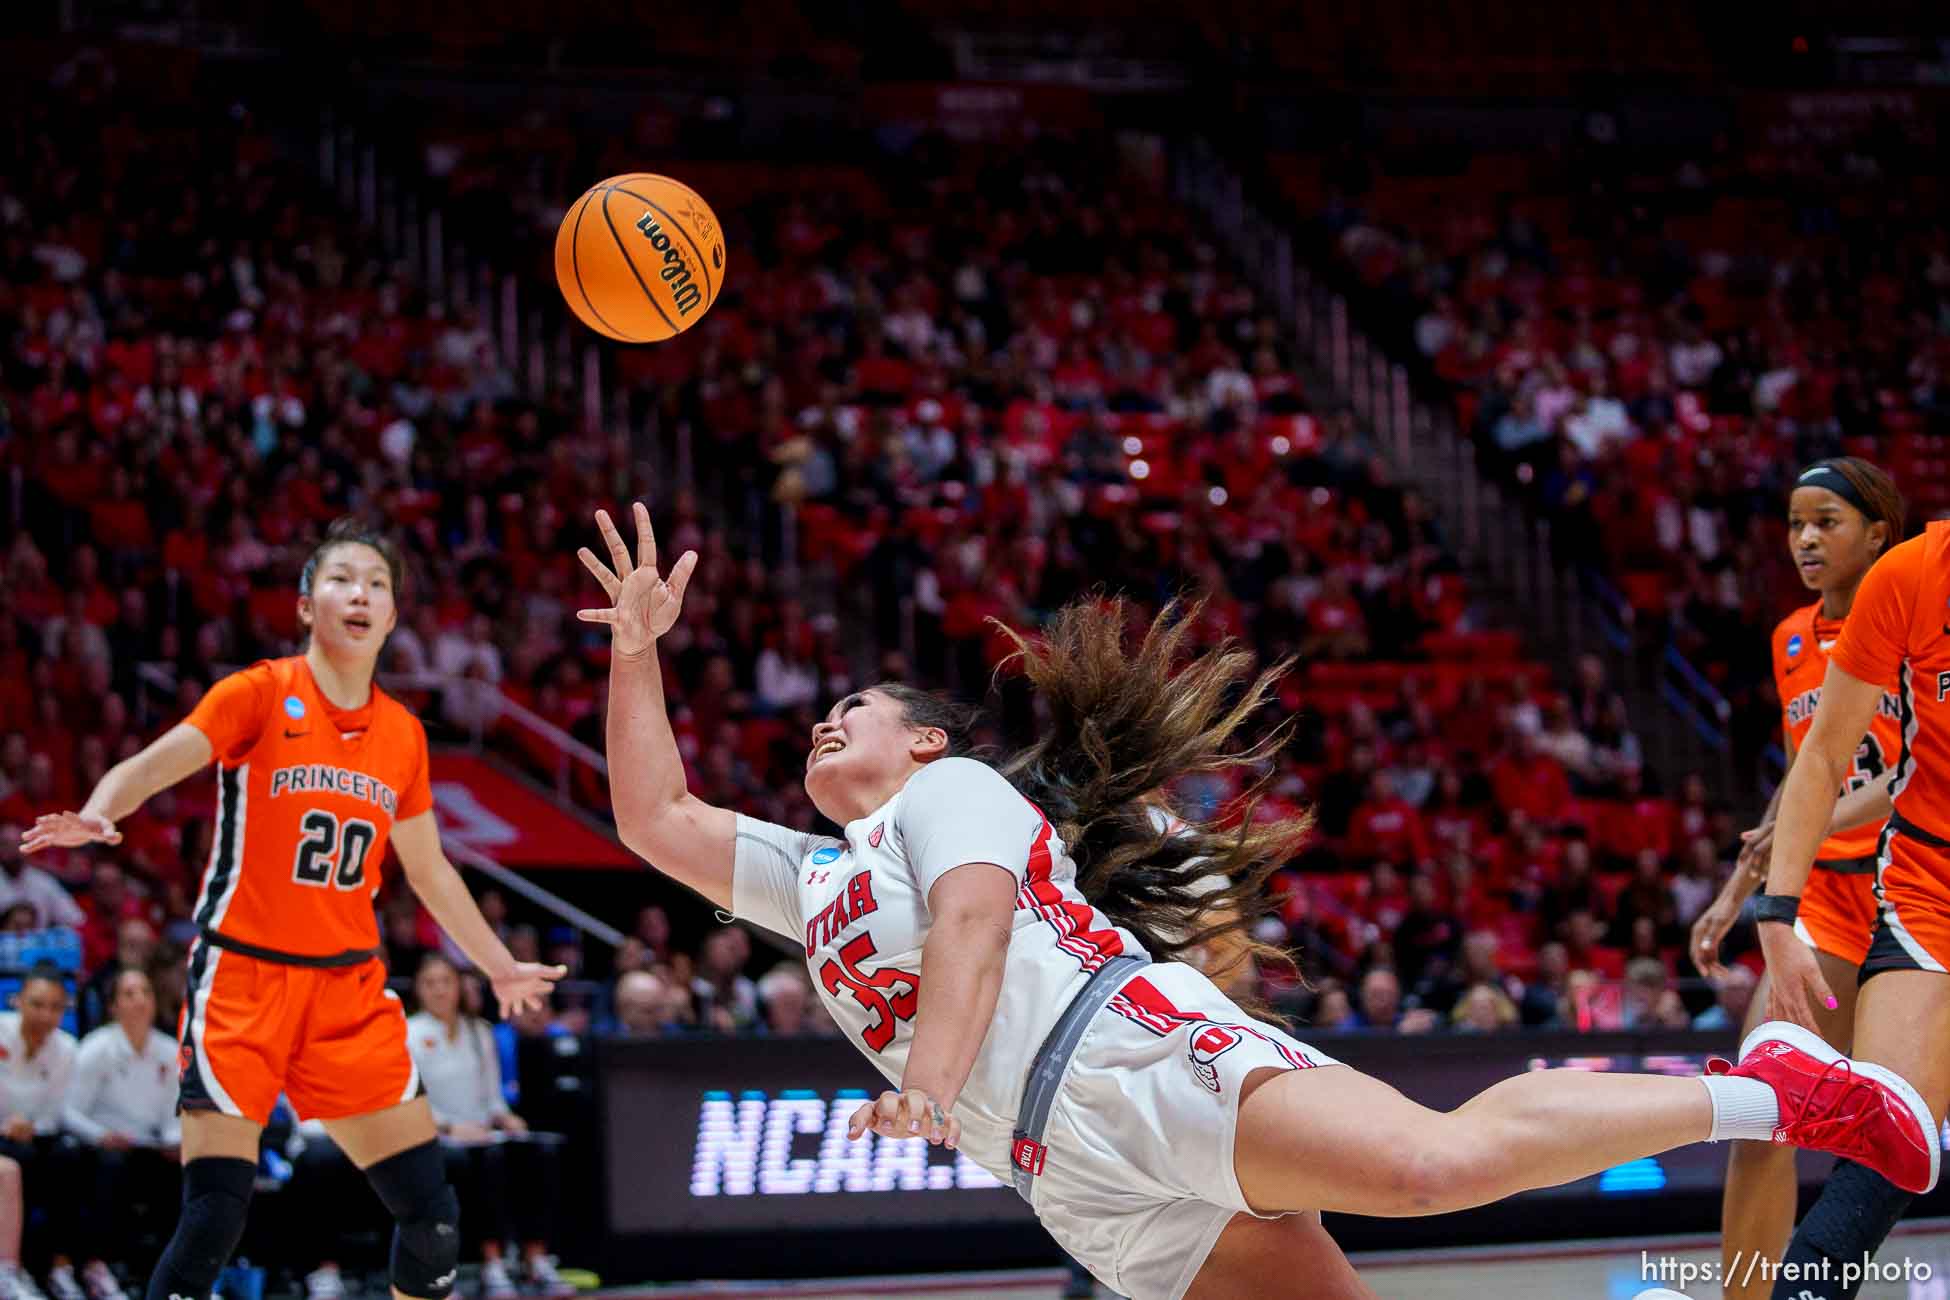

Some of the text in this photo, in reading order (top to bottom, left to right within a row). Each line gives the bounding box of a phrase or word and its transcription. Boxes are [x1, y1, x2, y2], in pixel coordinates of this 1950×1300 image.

[636, 211, 703, 318] Wilson
[269, 764, 398, 818] PRINCETO
[292, 808, 377, 892] 20
[806, 869, 879, 959] UTAH
[820, 930, 920, 1055] 35
[1020, 1144, 1034, 1169] UTAH
